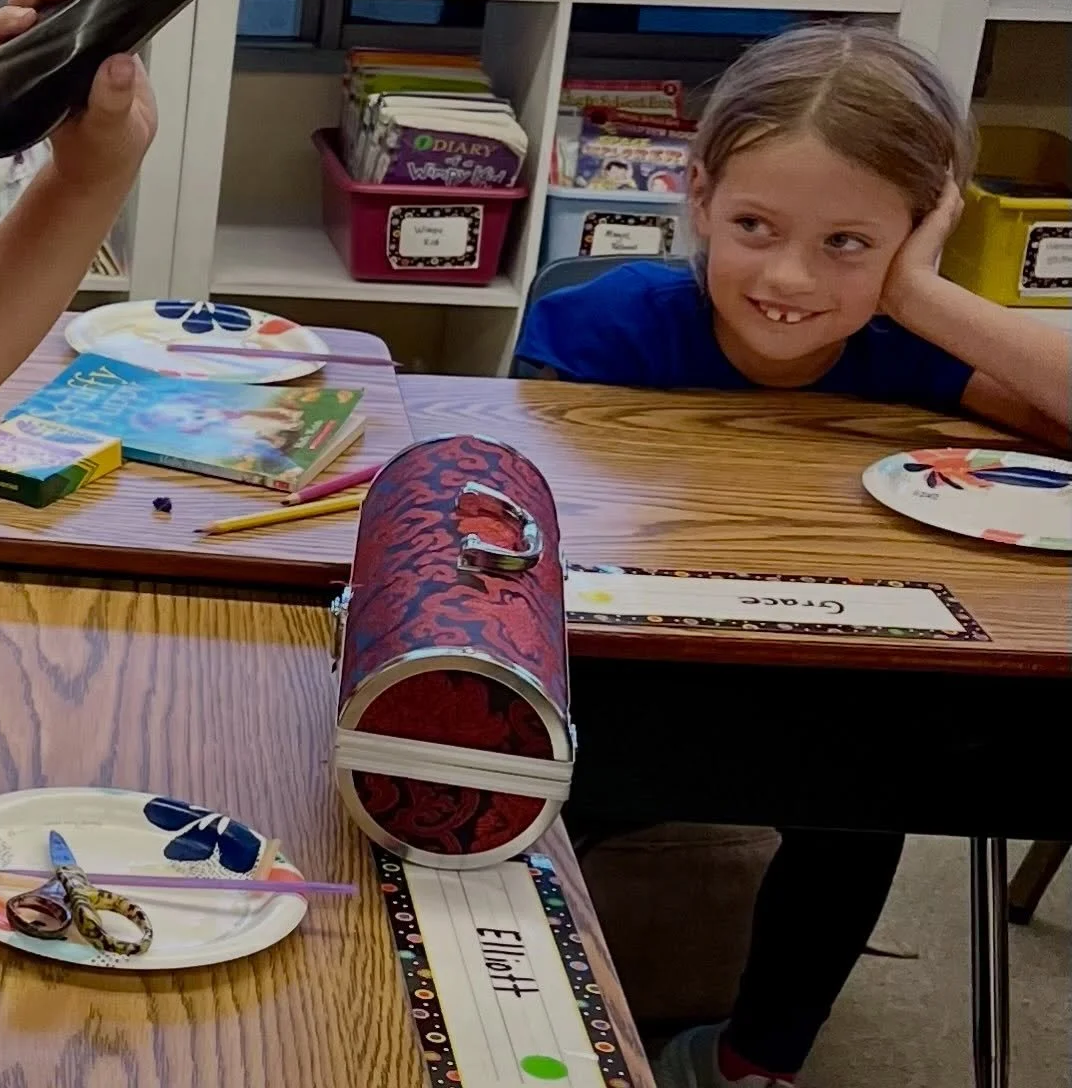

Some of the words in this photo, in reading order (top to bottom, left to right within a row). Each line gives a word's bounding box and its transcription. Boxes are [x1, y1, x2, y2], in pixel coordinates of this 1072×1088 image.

[432, 139, 498, 157] DIARY
[407, 162, 471, 186] Wimpy
[469, 165, 508, 186] Kid
[738, 595, 845, 615] Grace
[476, 927, 540, 998] Elliott
